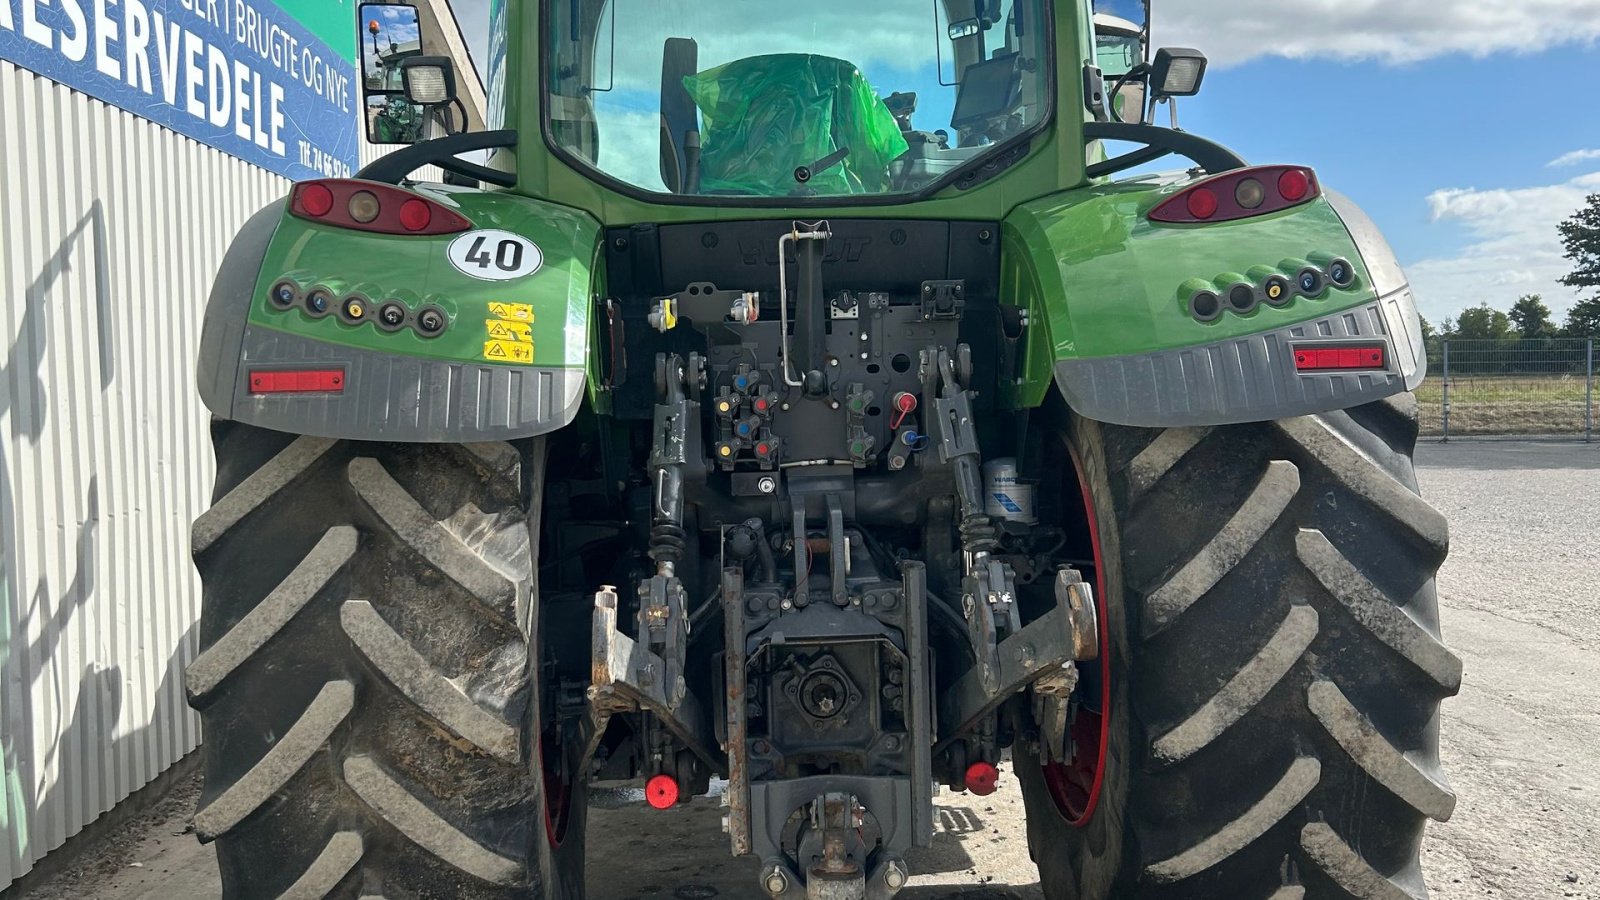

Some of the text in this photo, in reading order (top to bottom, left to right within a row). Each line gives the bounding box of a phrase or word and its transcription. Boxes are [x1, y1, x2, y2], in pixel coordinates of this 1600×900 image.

[0, 0, 286, 157] ESERVEDELE
[236, 0, 299, 80] BRUGTE
[302, 47, 323, 96] OG
[325, 63, 349, 113] NYE
[298, 139, 313, 169] Tlf.
[312, 147, 323, 173] 74
[323, 152, 333, 178] 66
[464, 236, 524, 272] 40
